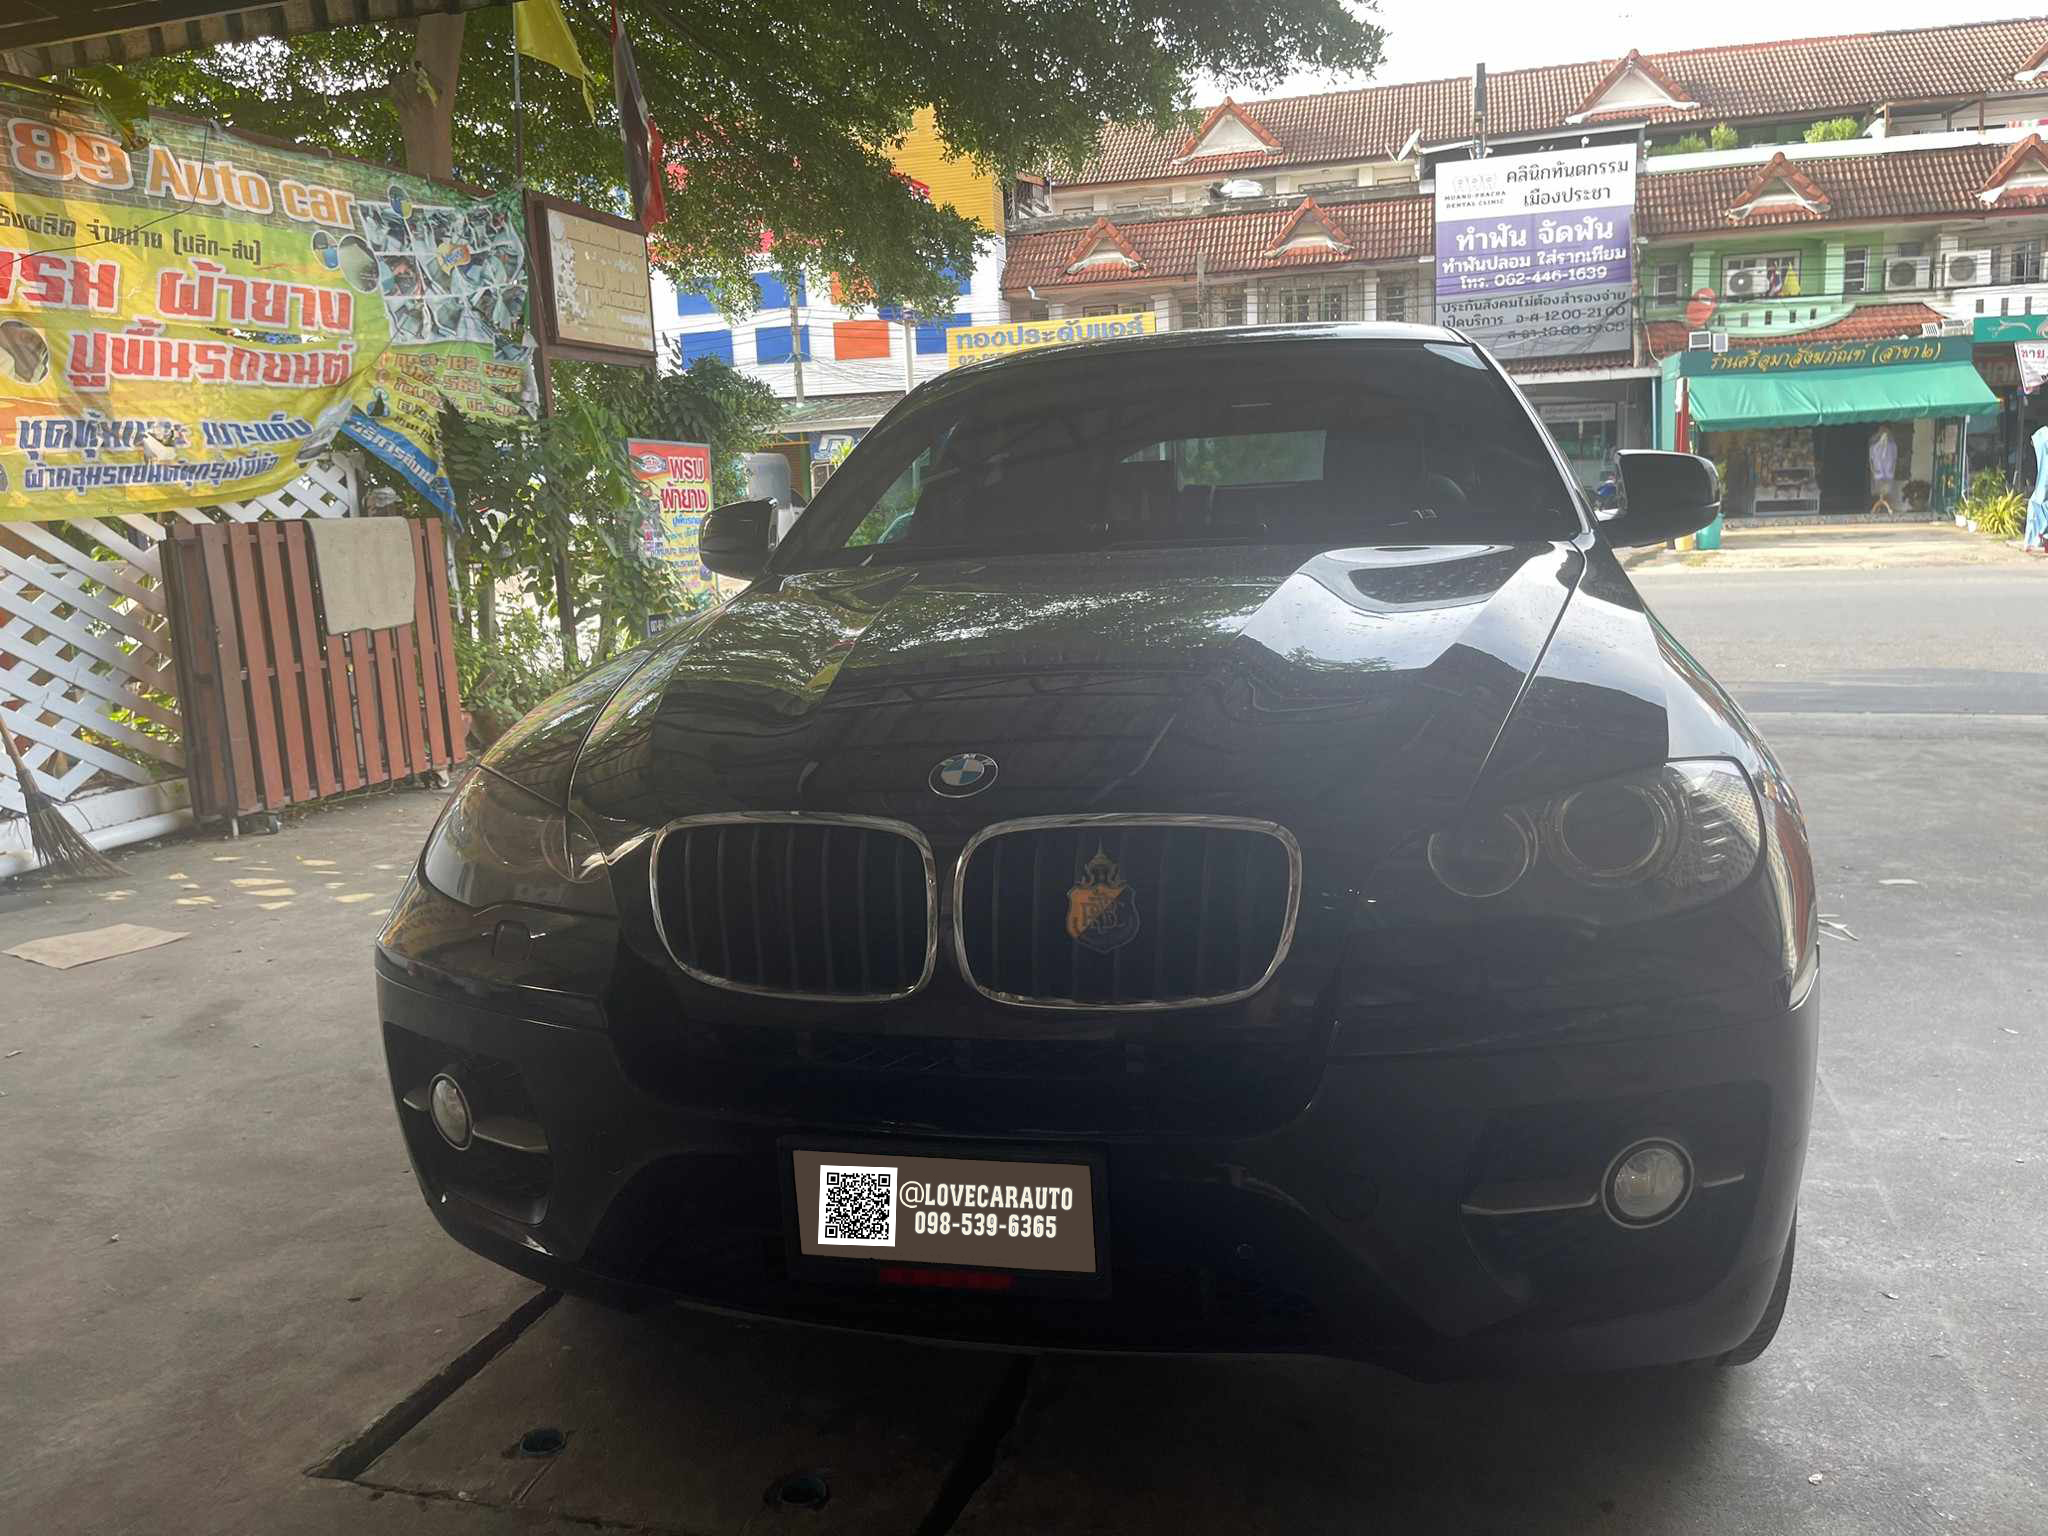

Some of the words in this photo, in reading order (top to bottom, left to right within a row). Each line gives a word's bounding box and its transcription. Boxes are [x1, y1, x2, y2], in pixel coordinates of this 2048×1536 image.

[8, 118, 134, 190] 89
[145, 144, 274, 214] Auto
[279, 180, 356, 229] car
[1506, 160, 1629, 184] คลินิกทันตกรรม
[1523, 186, 1612, 208] เมืองประชา
[1455, 223, 1527, 252] ทำฟัน
[1538, 216, 1614, 245] จัดฟัน
[1442, 255, 1531, 274] ทำฟันปลอม
[1536, 245, 1627, 266] ใส่รากเทียม
[158, 258, 354, 334] ผ้ายาง
[67, 317, 356, 392] ปูพื้นรถยนต์
[668, 456, 706, 483] พรม
[660, 481, 709, 515] ผ้ายาง
